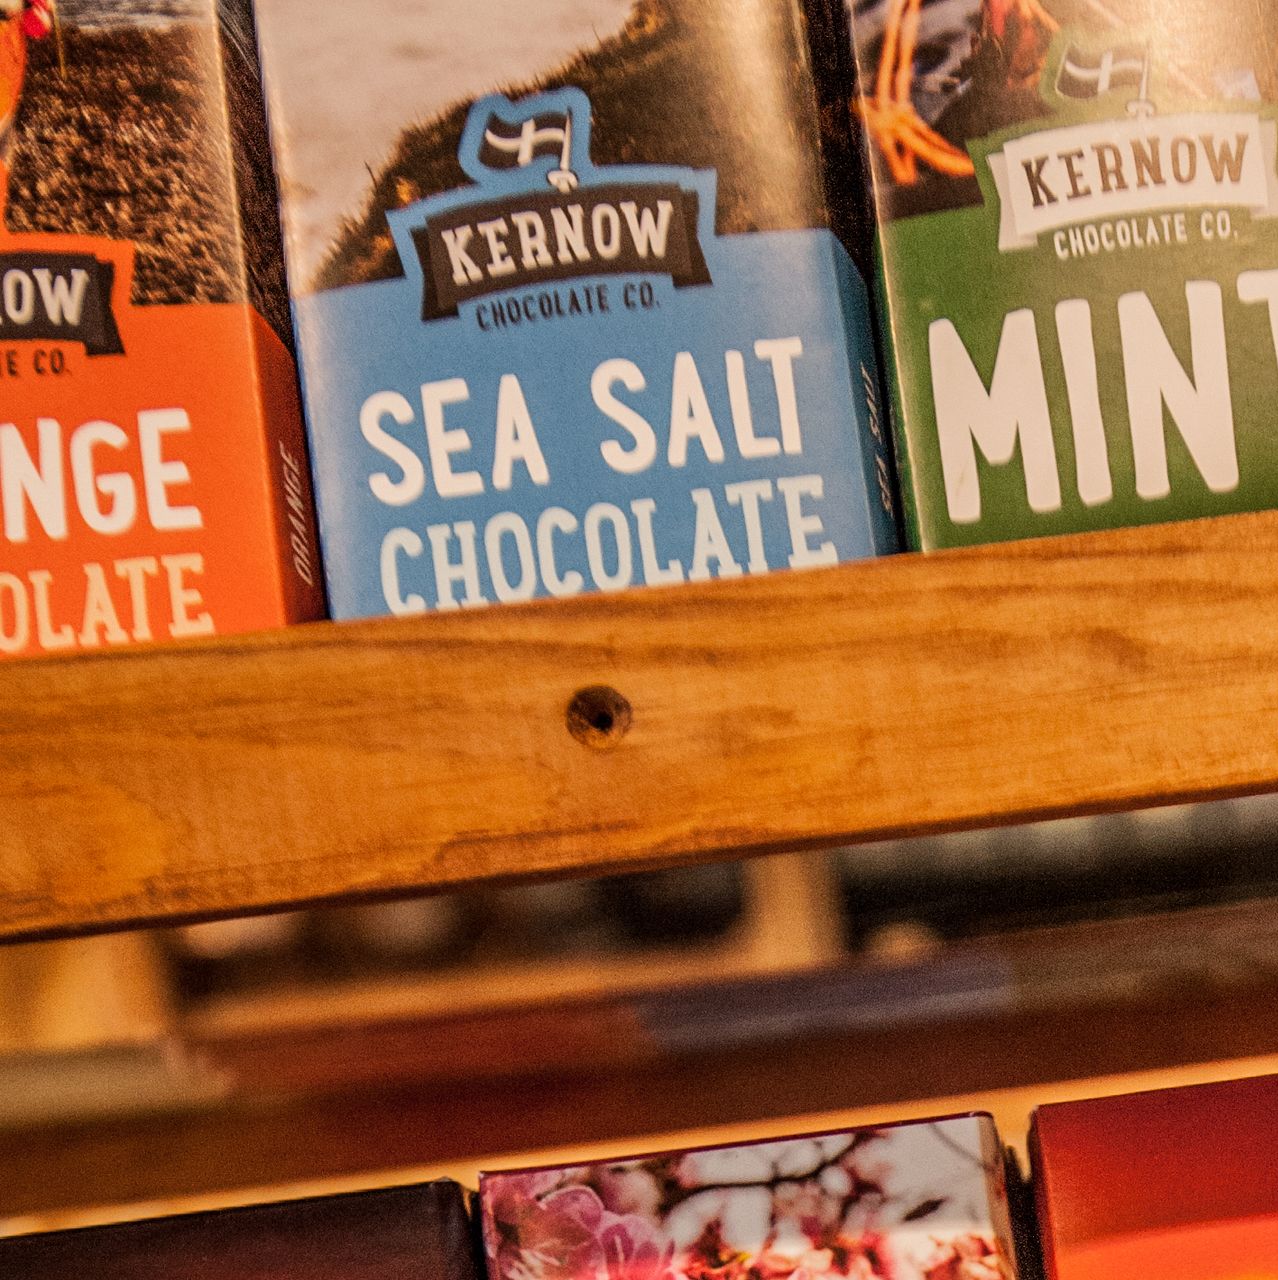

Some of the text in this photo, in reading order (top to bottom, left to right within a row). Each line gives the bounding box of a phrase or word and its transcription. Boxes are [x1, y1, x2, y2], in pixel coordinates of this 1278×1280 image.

[1021, 133, 1251, 208] KERNOW
[444, 200, 674, 285] KERNOW
[1052, 211, 1239, 260] CHOCOLATE CO.
[475, 280, 662, 331] CHOCOLATE CO.
[360, 337, 804, 505] SEA SALT
[279, 440, 313, 587] ORANGE
[380, 476, 839, 616] CHOCOLATE
